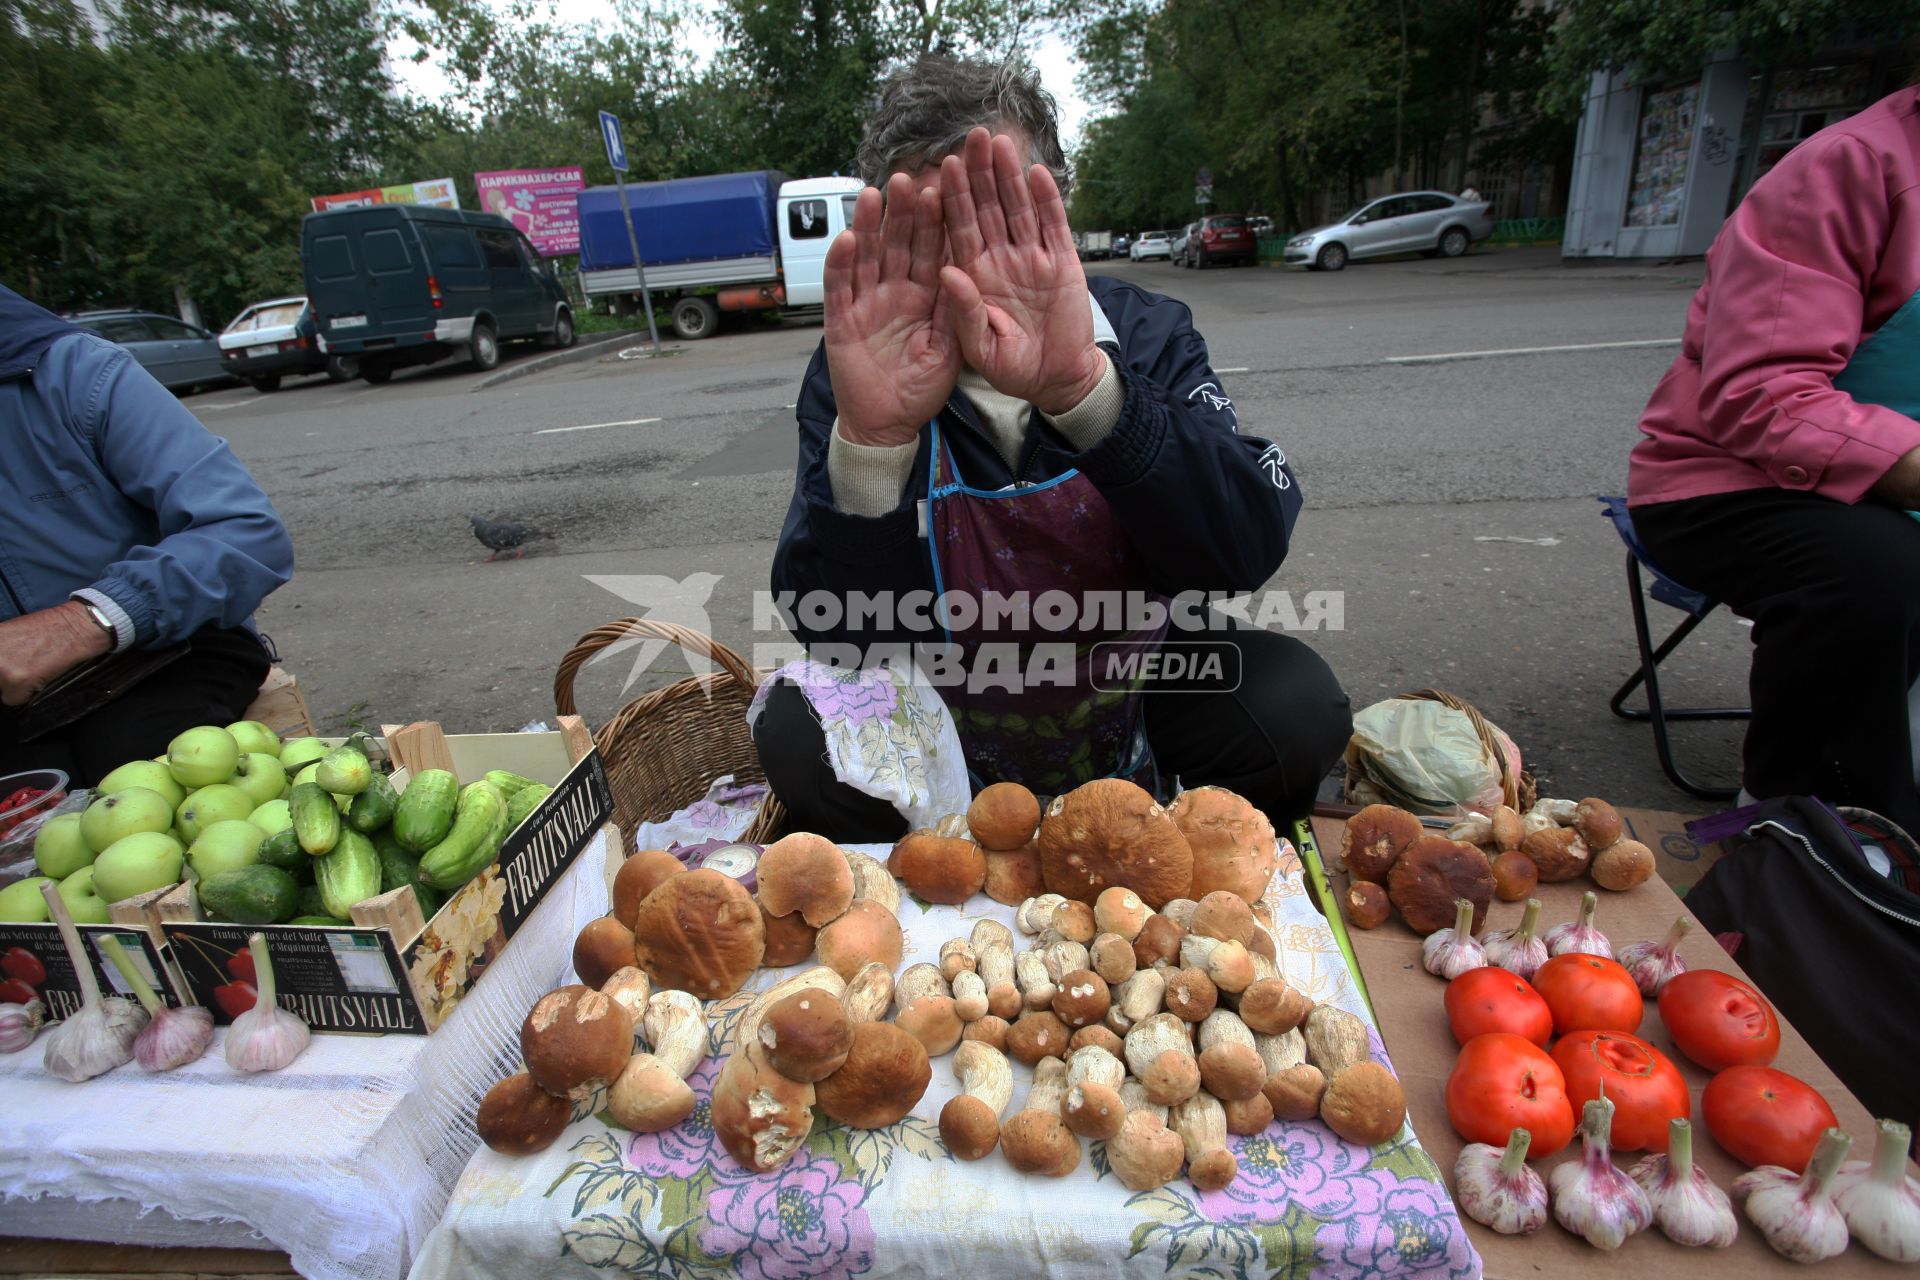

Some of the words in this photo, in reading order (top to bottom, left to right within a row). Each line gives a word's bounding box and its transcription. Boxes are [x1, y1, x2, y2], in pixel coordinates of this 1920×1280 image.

[480, 171, 581, 188] ПАРИКМАХЕРСКАЯ
[538, 199, 578, 210] ДОСТУПНЫ
[506, 776, 600, 918] FRUITSVALL
[213, 929, 241, 940] Frutas
